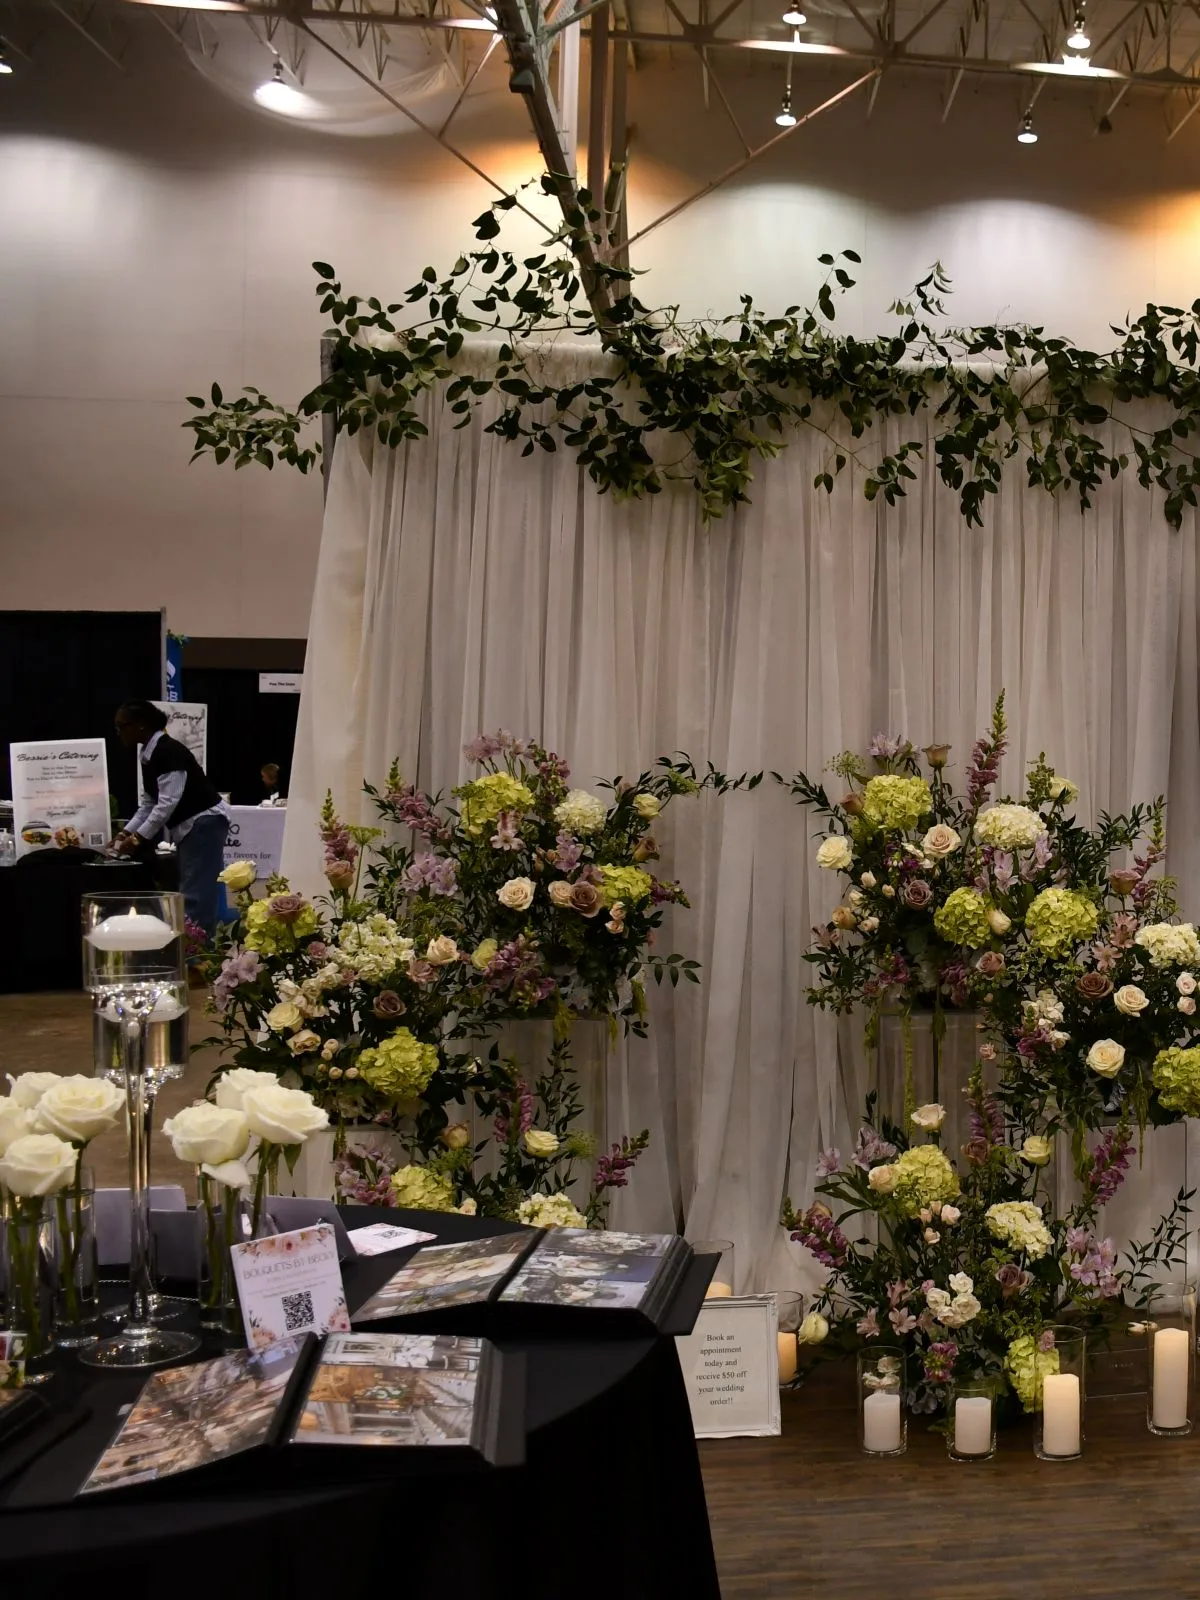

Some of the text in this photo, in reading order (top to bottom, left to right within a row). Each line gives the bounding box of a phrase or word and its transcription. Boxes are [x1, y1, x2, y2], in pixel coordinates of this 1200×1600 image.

[58, 751, 99, 762] Catering
[233, 851, 258, 859] favors
[259, 851, 271, 860] for
[243, 1261, 293, 1280] BOUQUETS
[294, 1257, 305, 1269] BY
[308, 1250, 335, 1265] BECKY
[706, 1333, 725, 1341] Book
[699, 1346, 742, 1356] appointment
[704, 1359, 723, 1368] today
[696, 1370, 748, 1381] receive $50 off
[698, 1384, 745, 1395] your wedding
[710, 1397, 733, 1405] order!!
